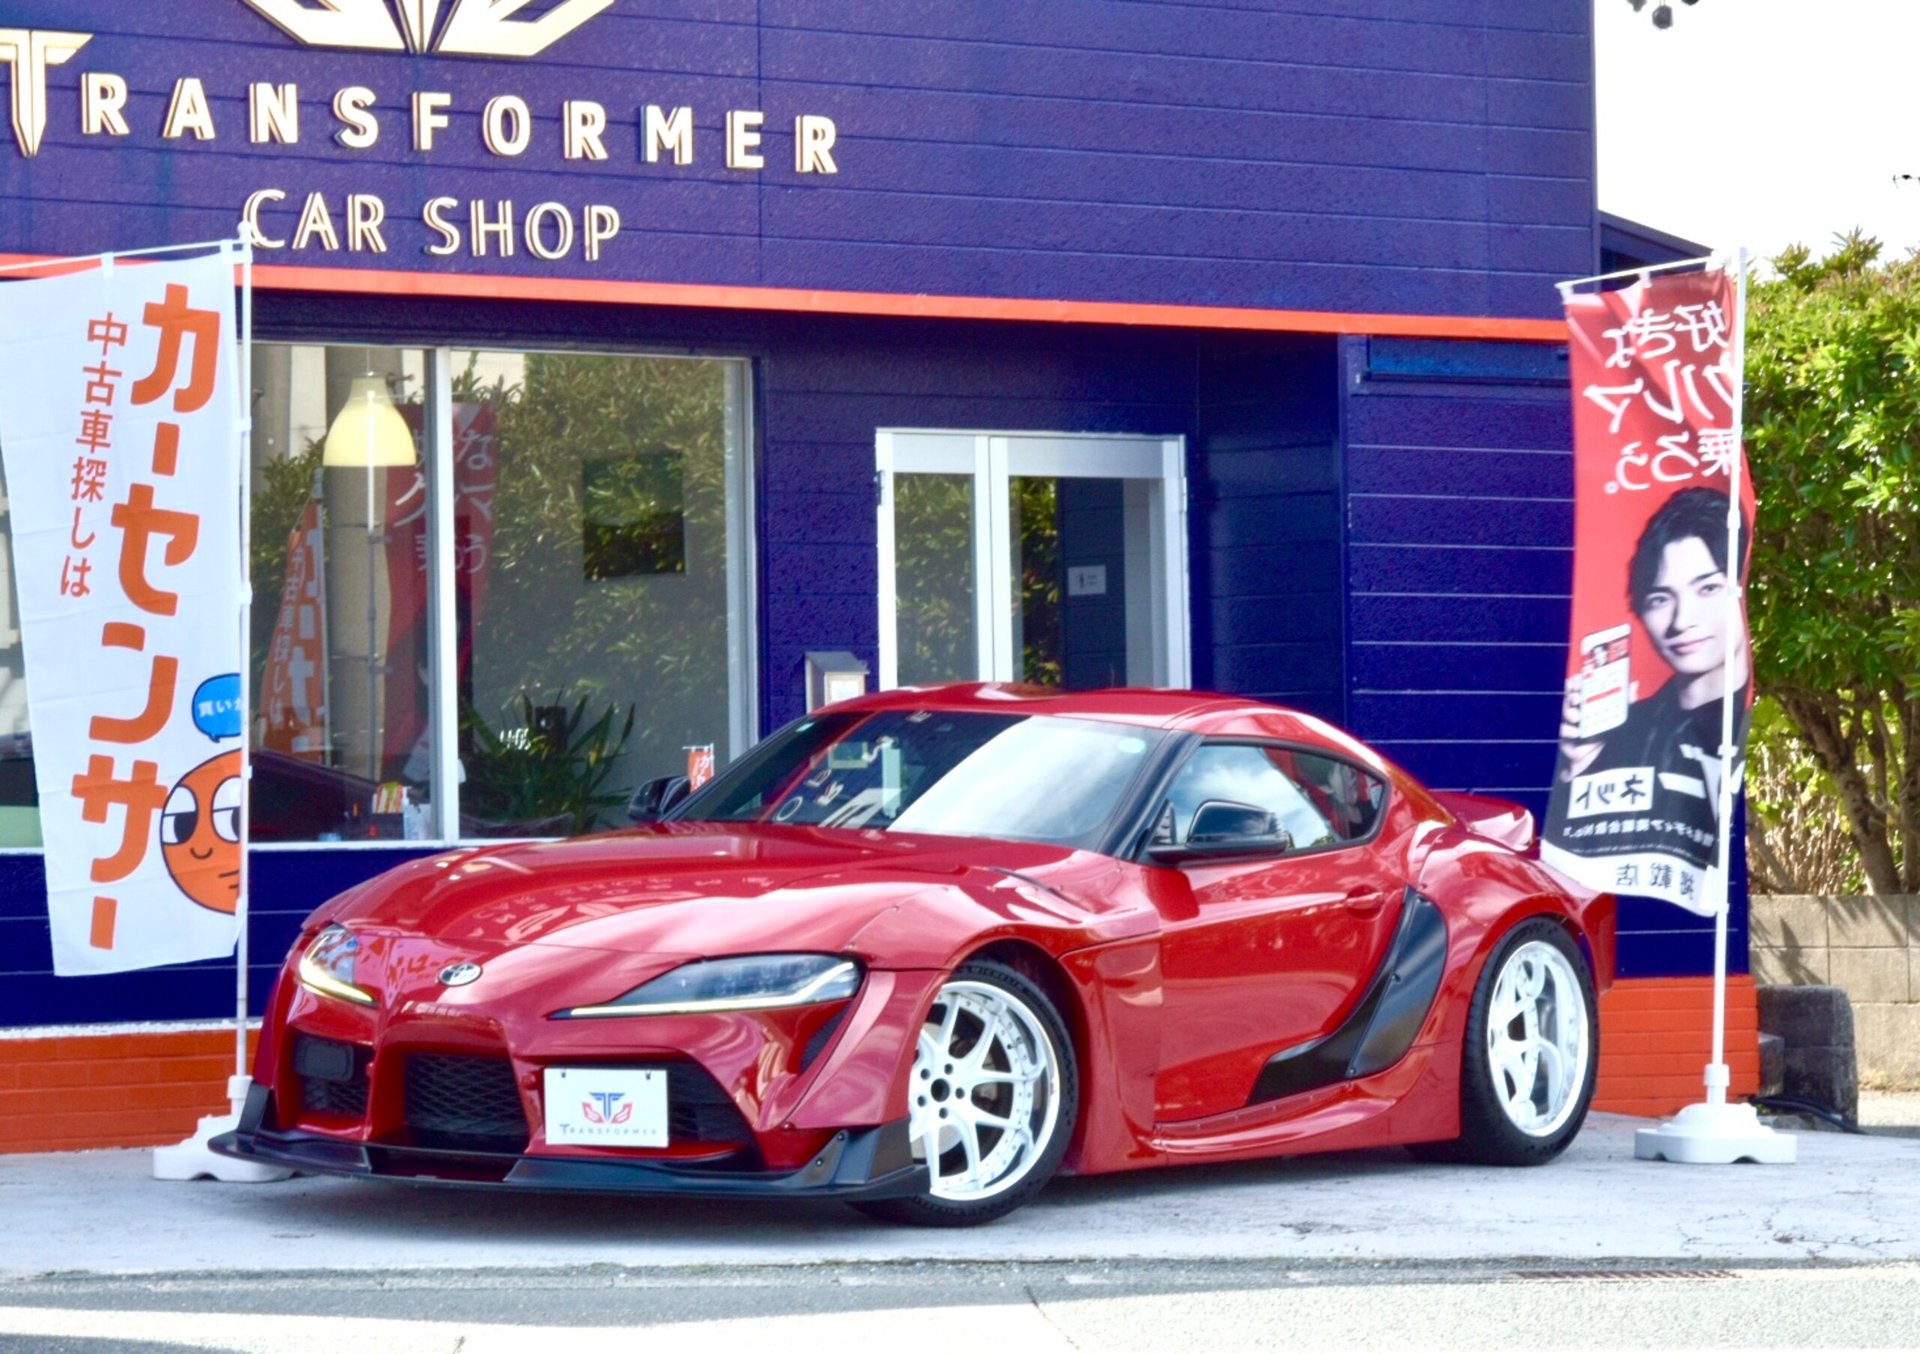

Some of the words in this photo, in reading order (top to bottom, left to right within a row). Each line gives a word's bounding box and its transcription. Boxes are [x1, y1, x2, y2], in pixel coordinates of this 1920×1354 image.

[0, 28, 838, 174] TRANSFORMER
[244, 189, 387, 253] CAR
[422, 197, 621, 261] SHOP
[60, 312, 128, 598] 中古車探しは
[71, 283, 220, 950] カーセンサー
